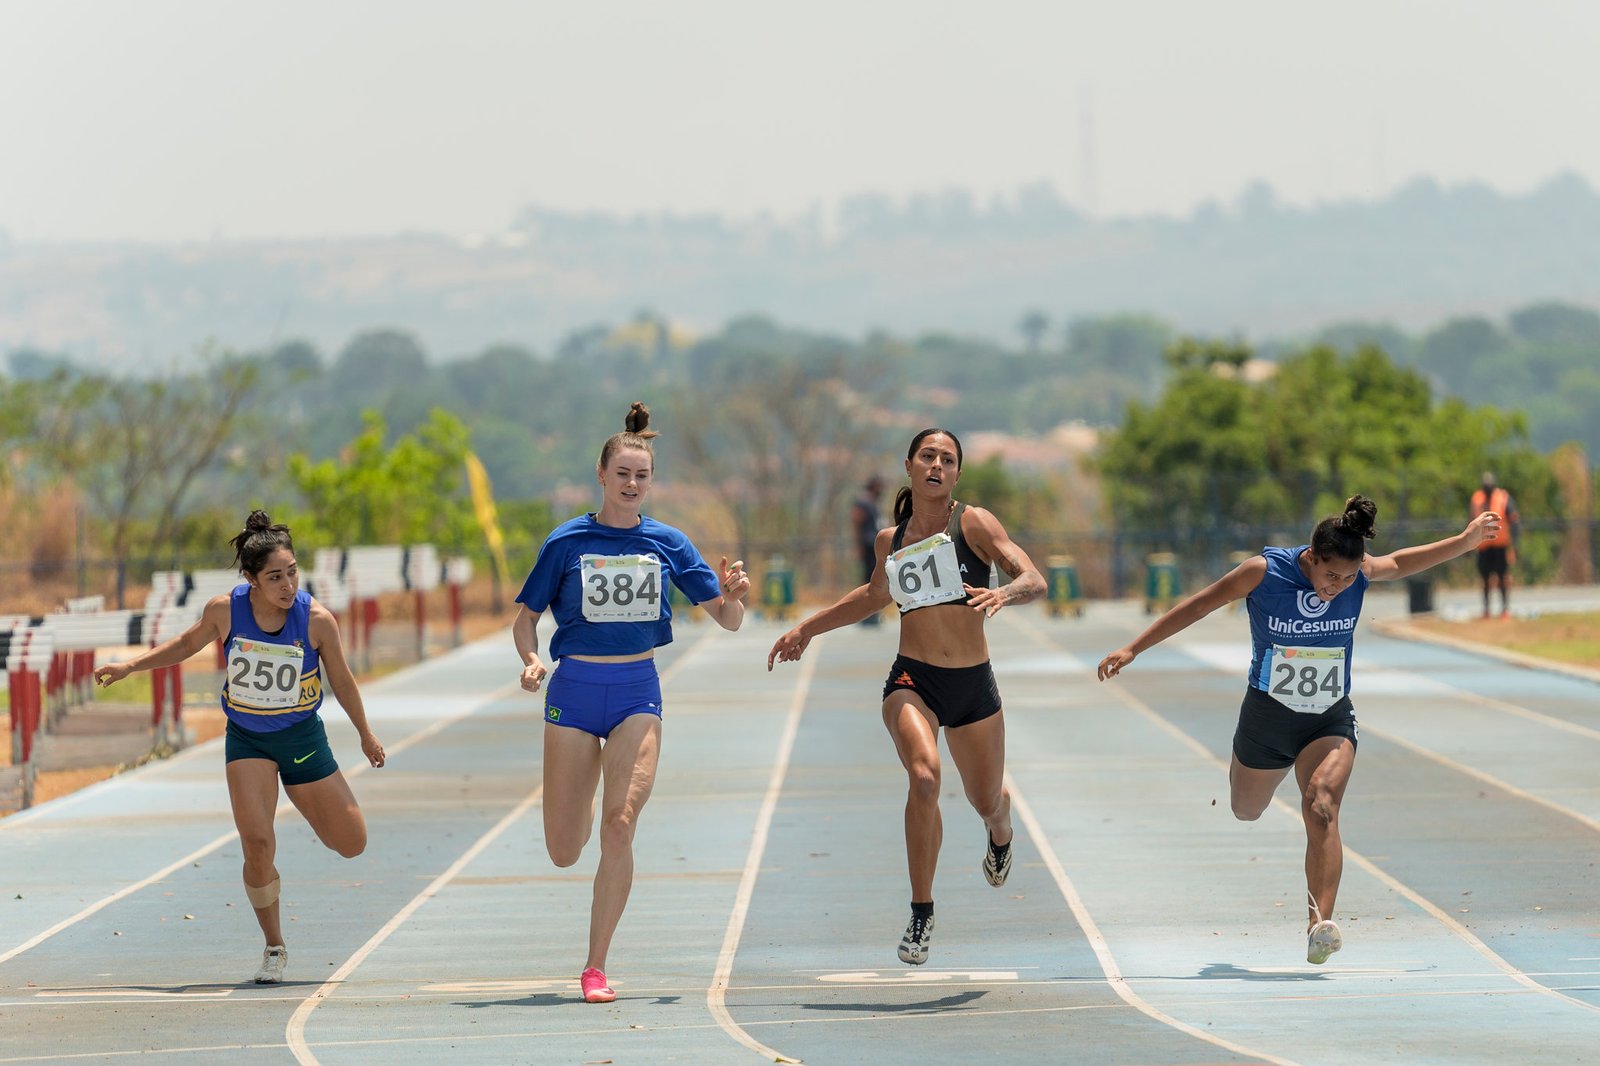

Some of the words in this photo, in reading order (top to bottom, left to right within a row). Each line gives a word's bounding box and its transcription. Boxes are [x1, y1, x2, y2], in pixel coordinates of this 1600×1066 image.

[587, 572, 659, 606] 384
[898, 554, 942, 594] 61
[1268, 615, 1356, 634] UniCesumar
[231, 656, 297, 692] 250
[1272, 663, 1342, 698] 284
